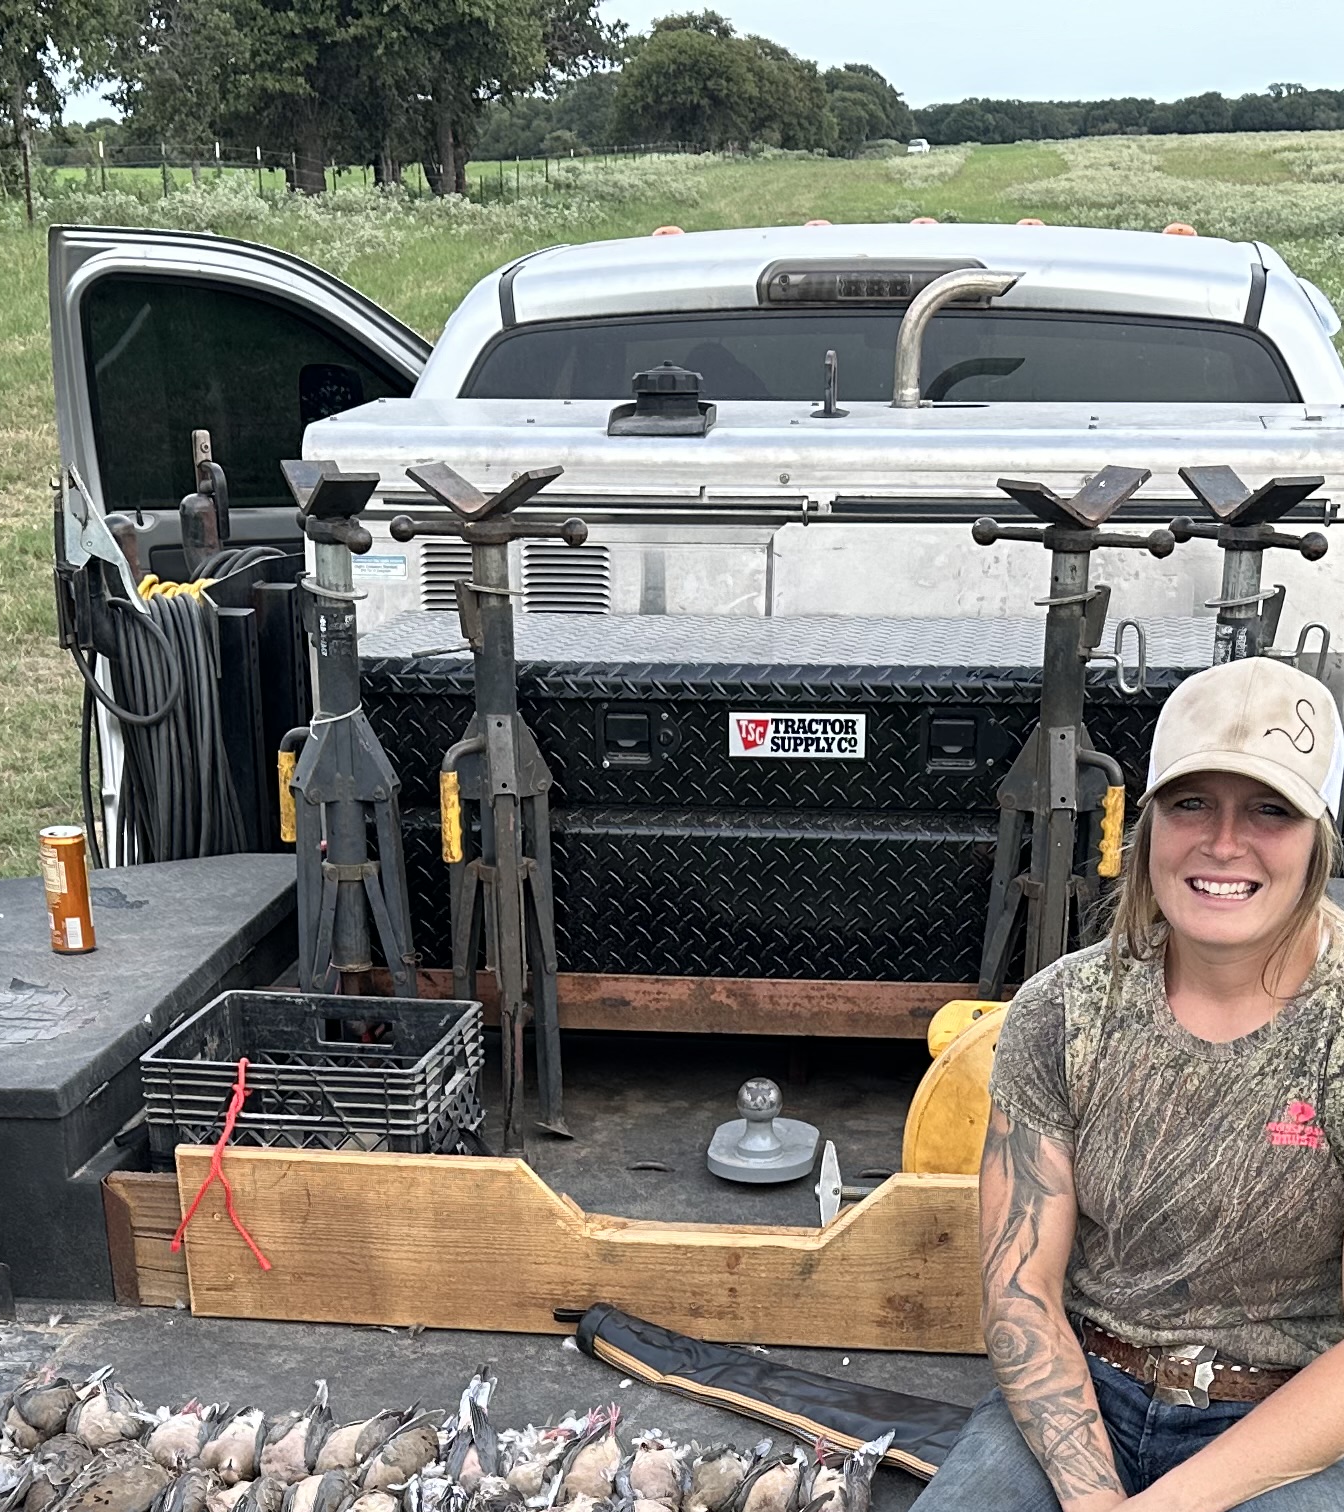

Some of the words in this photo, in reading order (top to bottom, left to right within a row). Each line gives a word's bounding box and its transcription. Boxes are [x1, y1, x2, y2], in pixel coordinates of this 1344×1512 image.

[739, 720, 765, 745] TSC
[771, 718, 857, 735] TRACTOR
[771, 736, 836, 753] SUPPLY
